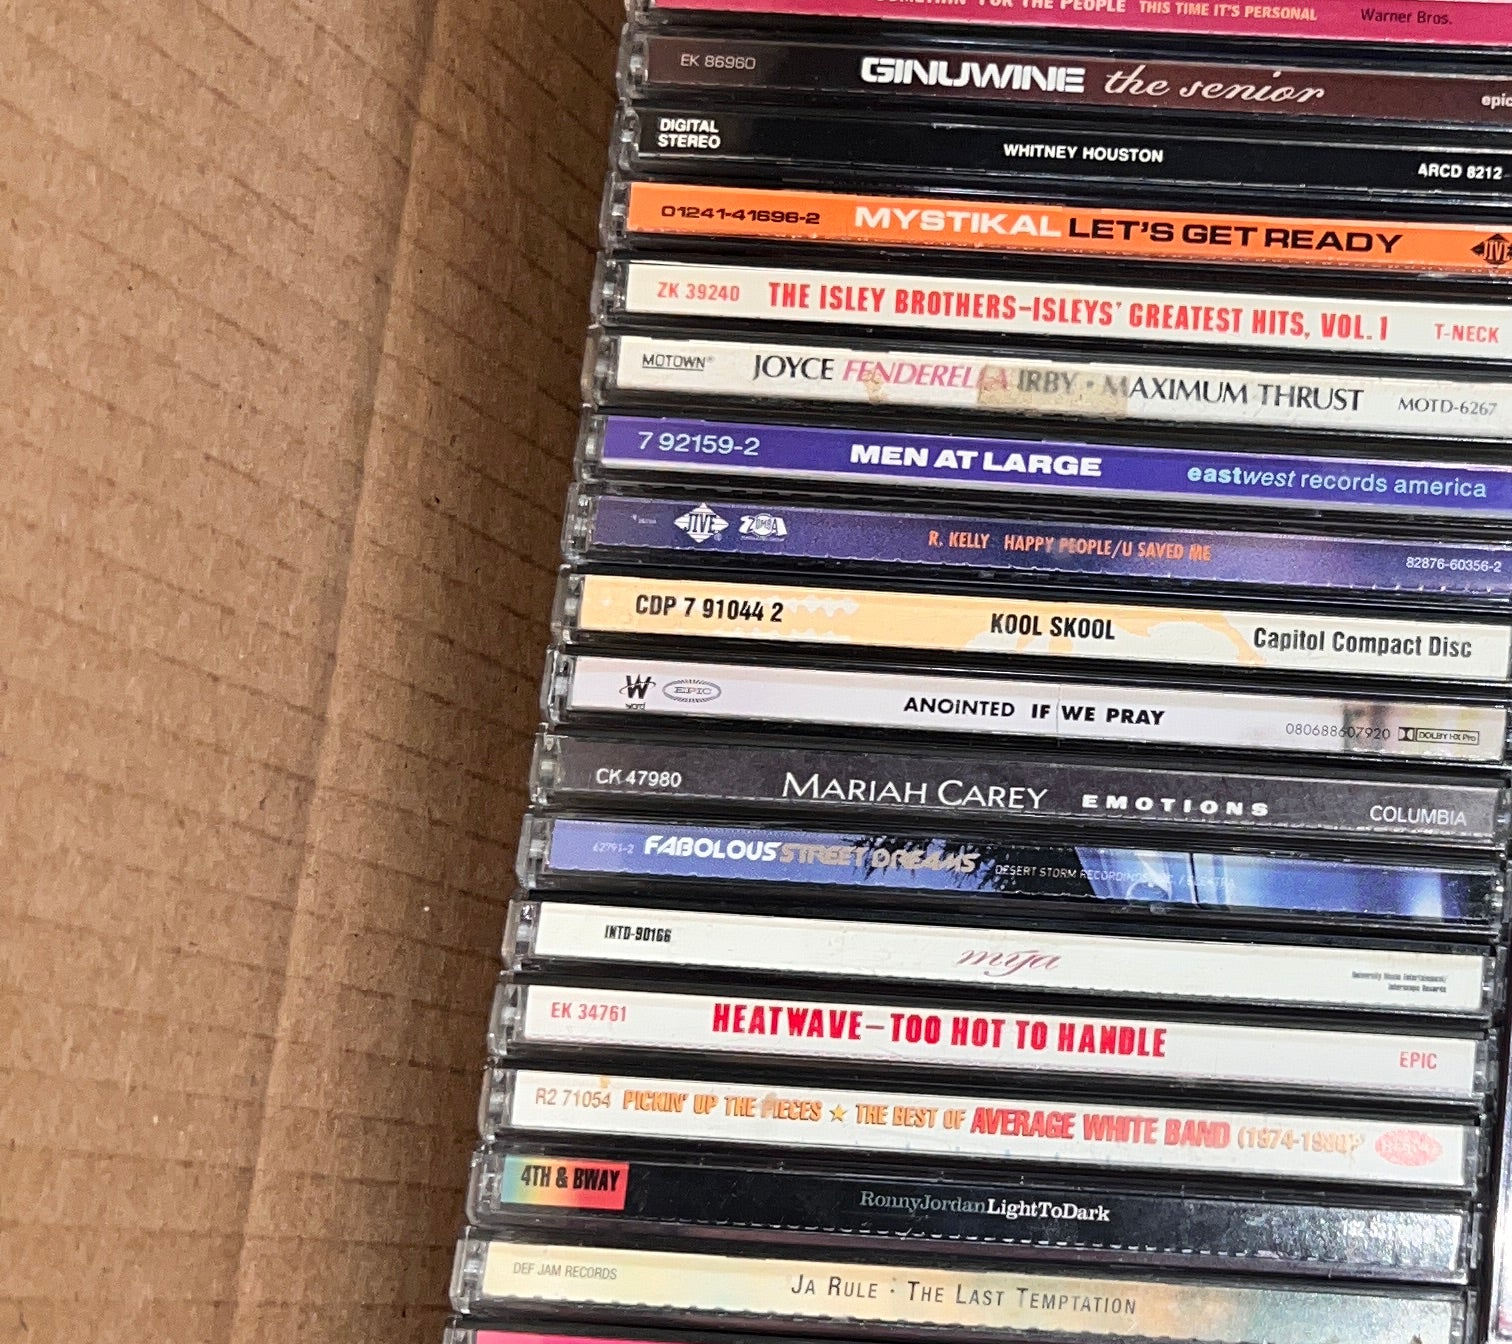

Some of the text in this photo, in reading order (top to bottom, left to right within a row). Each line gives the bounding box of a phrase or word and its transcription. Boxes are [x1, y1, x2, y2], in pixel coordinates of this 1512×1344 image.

[681, 54, 756, 70] EK 86960
[860, 57, 1326, 104] GINUWINE the senior
[660, 118, 719, 133] DIGITAL
[658, 134, 721, 149] STEREO
[1003, 143, 1164, 163] WHITNEY HOUSTON
[1417, 163, 1502, 180] ARCD 8212
[854, 206, 1404, 253] MYSTIKAL LET'S GET READY
[1398, 397, 1498, 416] MOTD-6267
[638, 432, 761, 455] 7 92159-2
[850, 444, 1102, 477] MEN AT LARGE
[1187, 465, 1487, 498] eastwest records america
[1406, 556, 1502, 573] 82876-60356-2
[990, 612, 1115, 640] KOOL SKOOL
[1253, 628, 1472, 658] Capitol Compact Disc
[1031, 704, 1050, 720] IF
[1062, 705, 1095, 722] WE
[1106, 708, 1165, 726] PRAY
[781, 772, 1269, 816] MARIAH CAREY EMOTIONS
[1369, 804, 1466, 826] COLUMBIA
[520, 1164, 620, 1191] 4TH & BWAY
